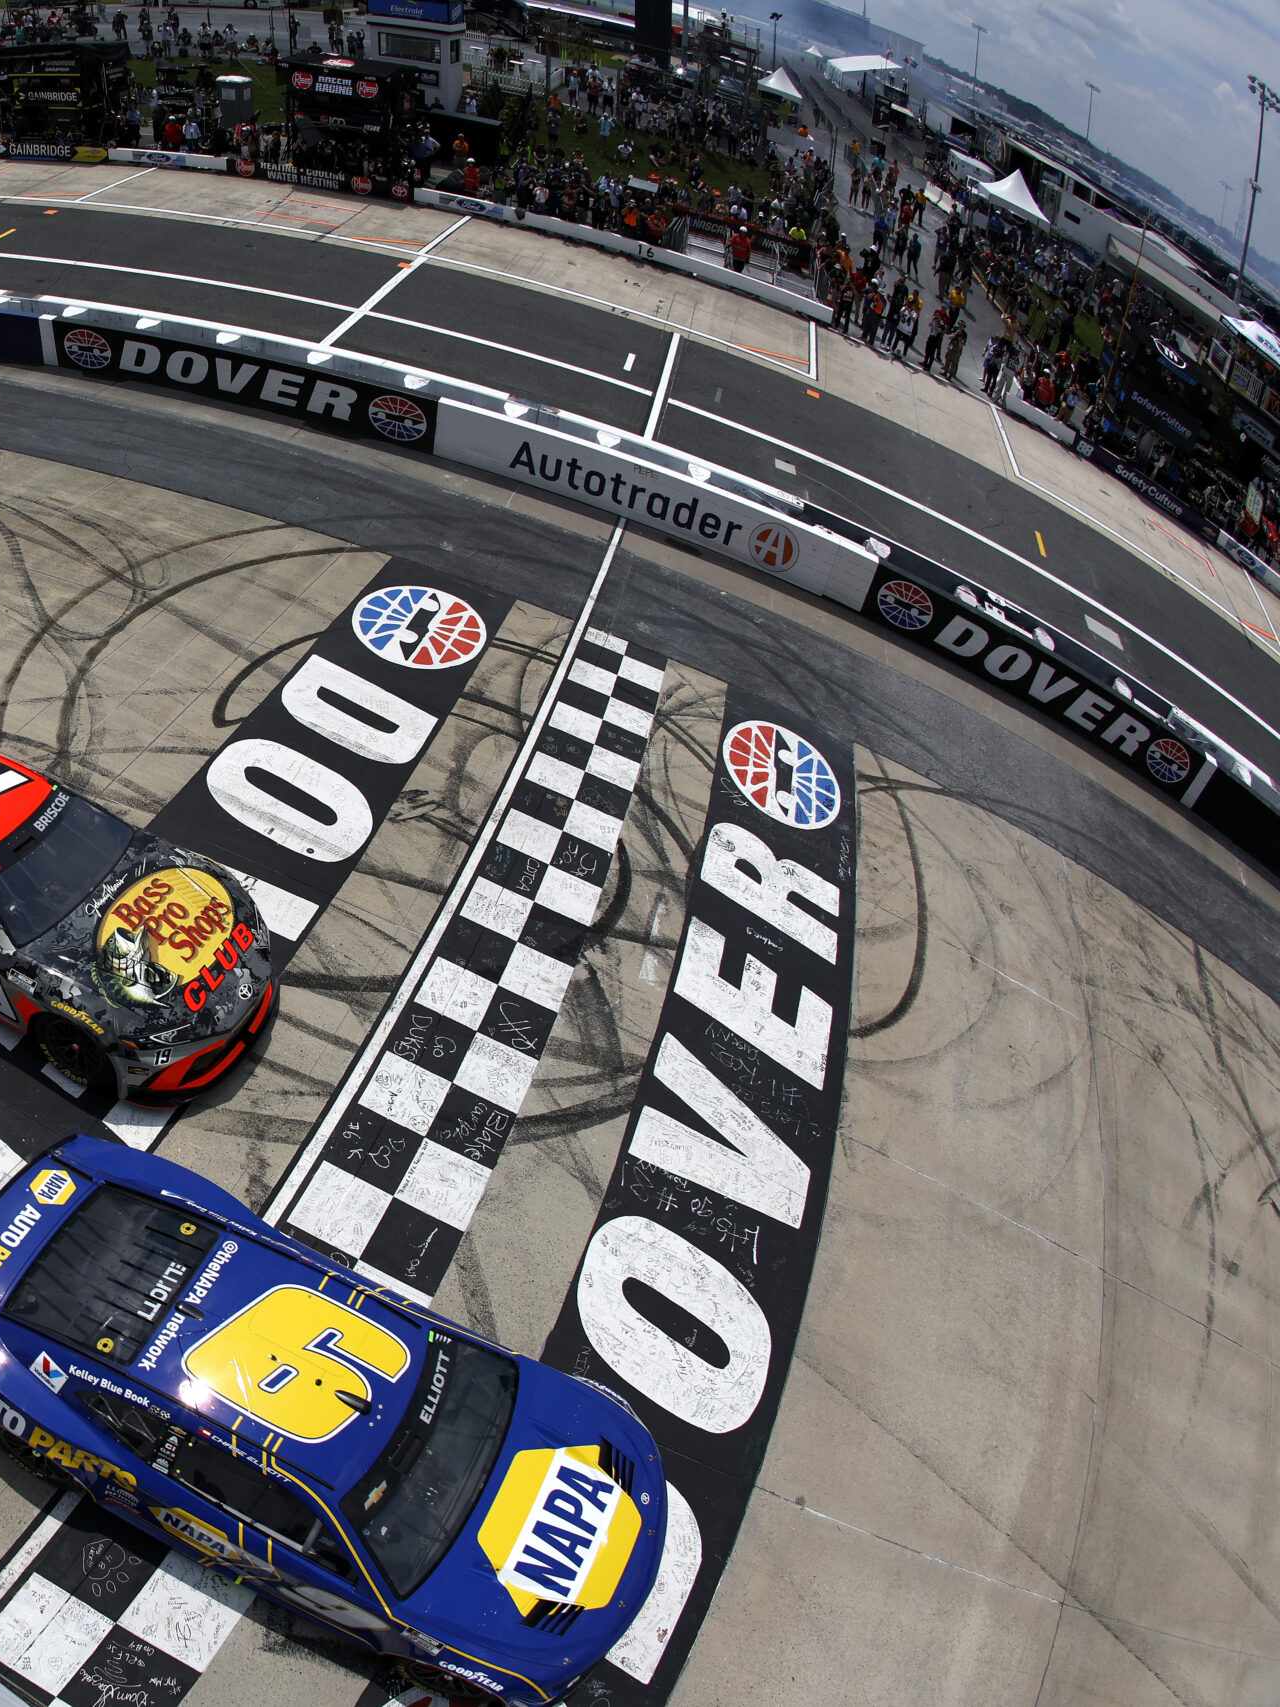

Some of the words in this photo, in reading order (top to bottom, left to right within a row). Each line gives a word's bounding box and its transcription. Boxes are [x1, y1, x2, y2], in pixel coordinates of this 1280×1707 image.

[27, 91, 78, 102] GAINBRIDGE
[9, 142, 71, 158] GAINBRIDGE
[267, 170, 298, 184] WATER
[300, 175, 340, 190] HEATING
[636, 244, 655, 259] 16
[119, 339, 360, 423] DOVER
[1131, 391, 1193, 438] SafetyCulture
[508, 441, 743, 547] Autotrader
[1115, 463, 1183, 517] SafetyCulture
[934, 614, 1151, 758] DOVER
[33, 791, 70, 834] BRISCOE
[111, 877, 173, 932] Bass
[142, 900, 188, 946] Pro
[168, 895, 232, 963] Shops
[182, 922, 255, 1013] CLUB
[51, 1000, 105, 1036] GOODYEAR
[154, 1048, 172, 1066] 19
[37, 1171, 69, 1203] NAPA
[185, 1240, 239, 1306] @theNAPA
[136, 1311, 187, 1372] network
[180, 1283, 412, 1445] 9
[68, 1363, 102, 1387] Kelley
[100, 1377, 124, 1397] Blue
[123, 1388, 152, 1409] Book
[419, 1349, 452, 1426] ELLIOTT
[27, 1425, 139, 1494] PARTS
[210, 1434, 248, 1459] CHASE
[246, 1453, 293, 1484] ELLIOTT
[162, 1512, 231, 1558] NAPA
[513, 1464, 616, 1599] NAPA
[437, 1659, 505, 1694] GOODYEAR
